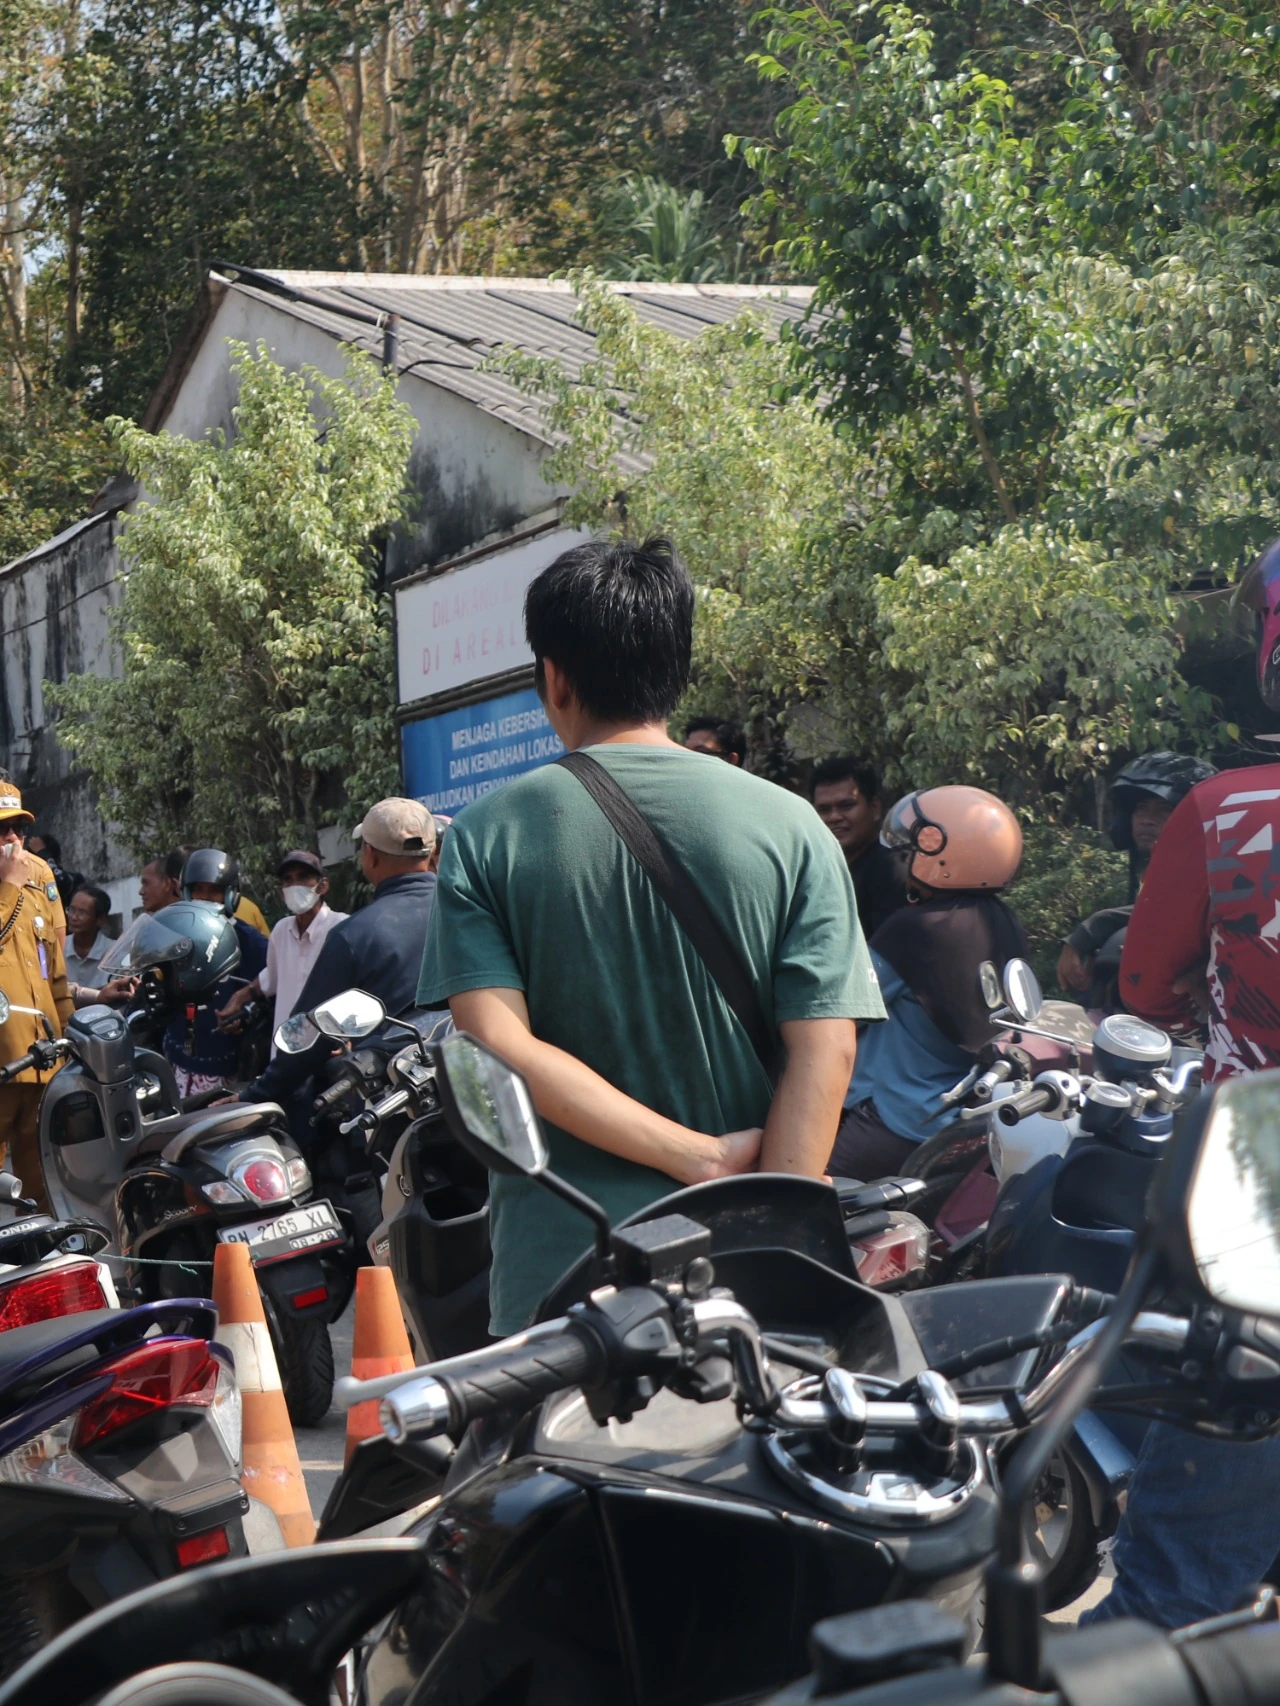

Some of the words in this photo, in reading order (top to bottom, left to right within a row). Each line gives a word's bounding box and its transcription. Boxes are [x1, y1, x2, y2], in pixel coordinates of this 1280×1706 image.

[422, 643, 440, 675] DI
[452, 620, 517, 664] AREAL
[452, 720, 497, 750] MENJAGA
[498, 707, 549, 739] KEBERSIH
[450, 757, 470, 780] DAN
[471, 741, 526, 774] KEINDAHAN
[415, 785, 476, 813] EWUJUDKAN
[257, 1218, 298, 1241] 2765
[306, 1209, 333, 1230] XL
